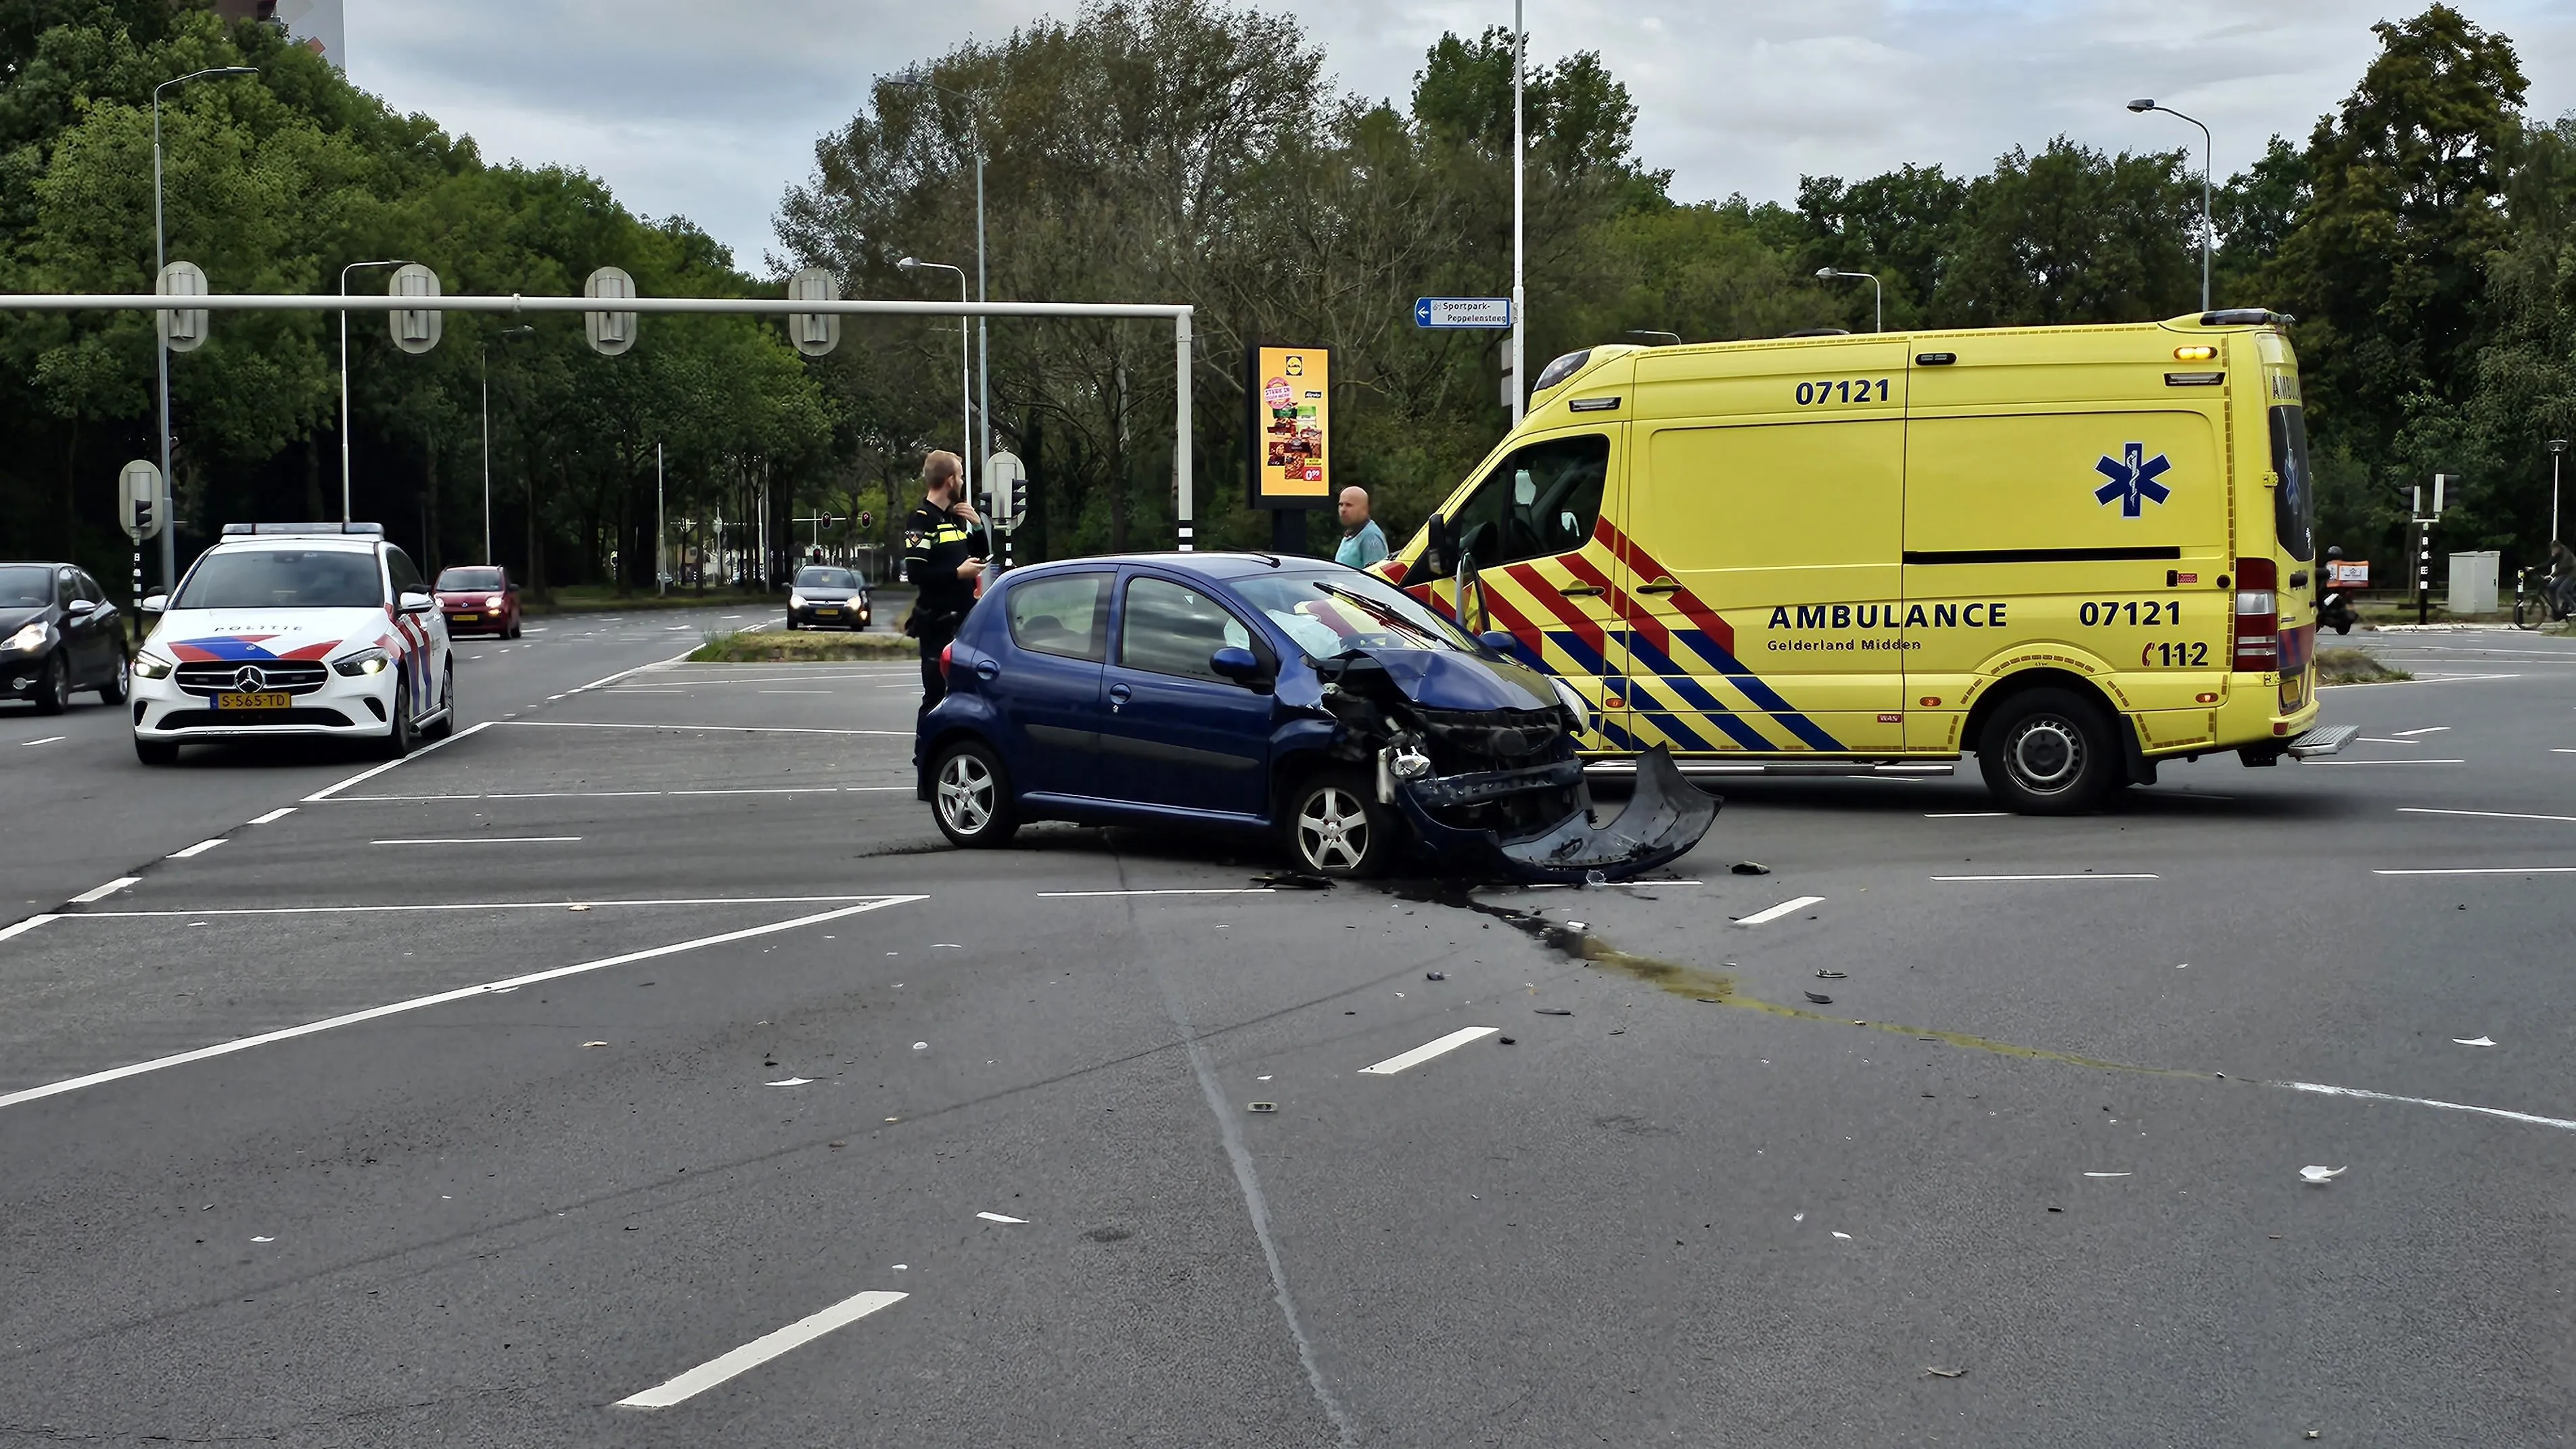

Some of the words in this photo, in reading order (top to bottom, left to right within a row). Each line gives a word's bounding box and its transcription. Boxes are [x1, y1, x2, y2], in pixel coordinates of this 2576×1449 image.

[1443, 302, 1490, 310] Sportpark-
[1447, 314, 1506, 323] Peppelensteeg
[1795, 379, 1889, 406] 07121
[1767, 603, 2008, 629] AMBULANCE
[2079, 601, 2180, 626] 07121
[1767, 639, 1854, 651] Gelderland
[1861, 640, 1921, 650] Midden
[222, 695, 285, 707] S-565-TD
